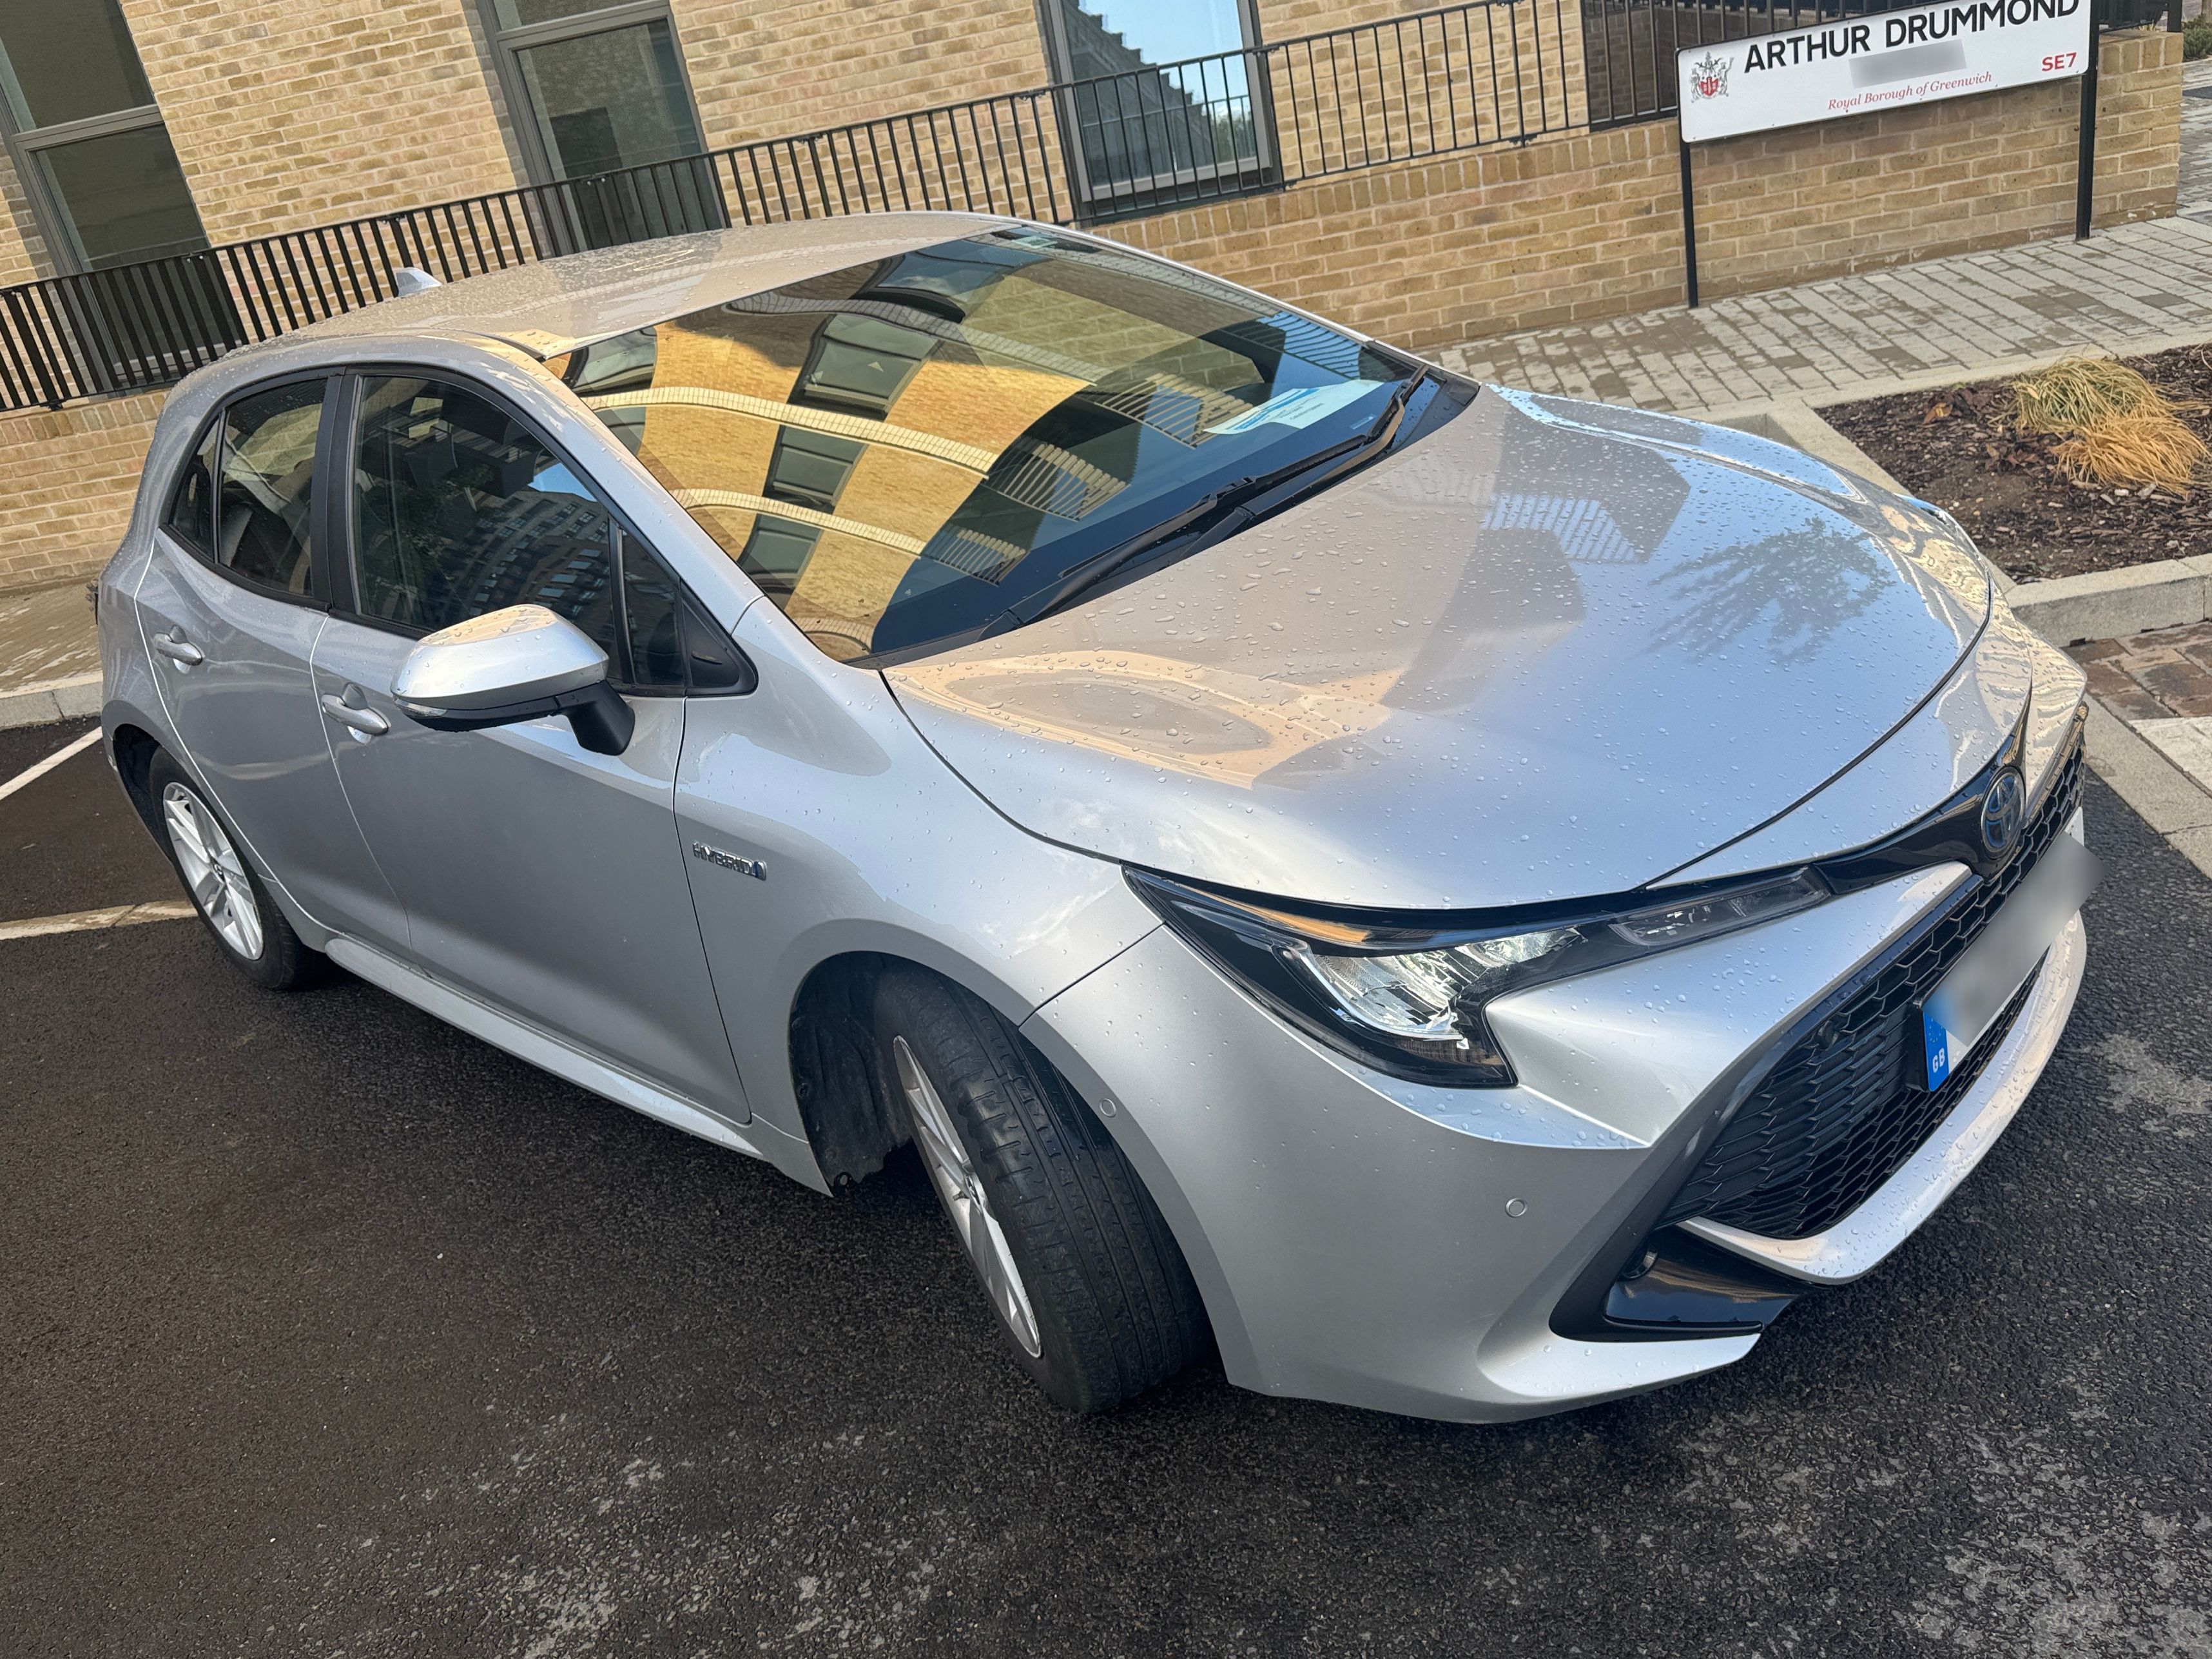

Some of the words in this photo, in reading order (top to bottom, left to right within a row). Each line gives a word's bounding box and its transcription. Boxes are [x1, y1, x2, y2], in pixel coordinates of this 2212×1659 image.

[1744, 24, 1871, 73] ARTHUR
[1885, 0, 2080, 48] DRUMMOND
[2042, 52, 2077, 72] SE7
[1828, 94, 1861, 110] Royal
[1865, 85, 1913, 103] Borough
[1916, 82, 1929, 95] of
[1930, 71, 1992, 92] Greenwich
[692, 840, 755, 877] HYBRID
[1932, 1047, 1945, 1073] GB
